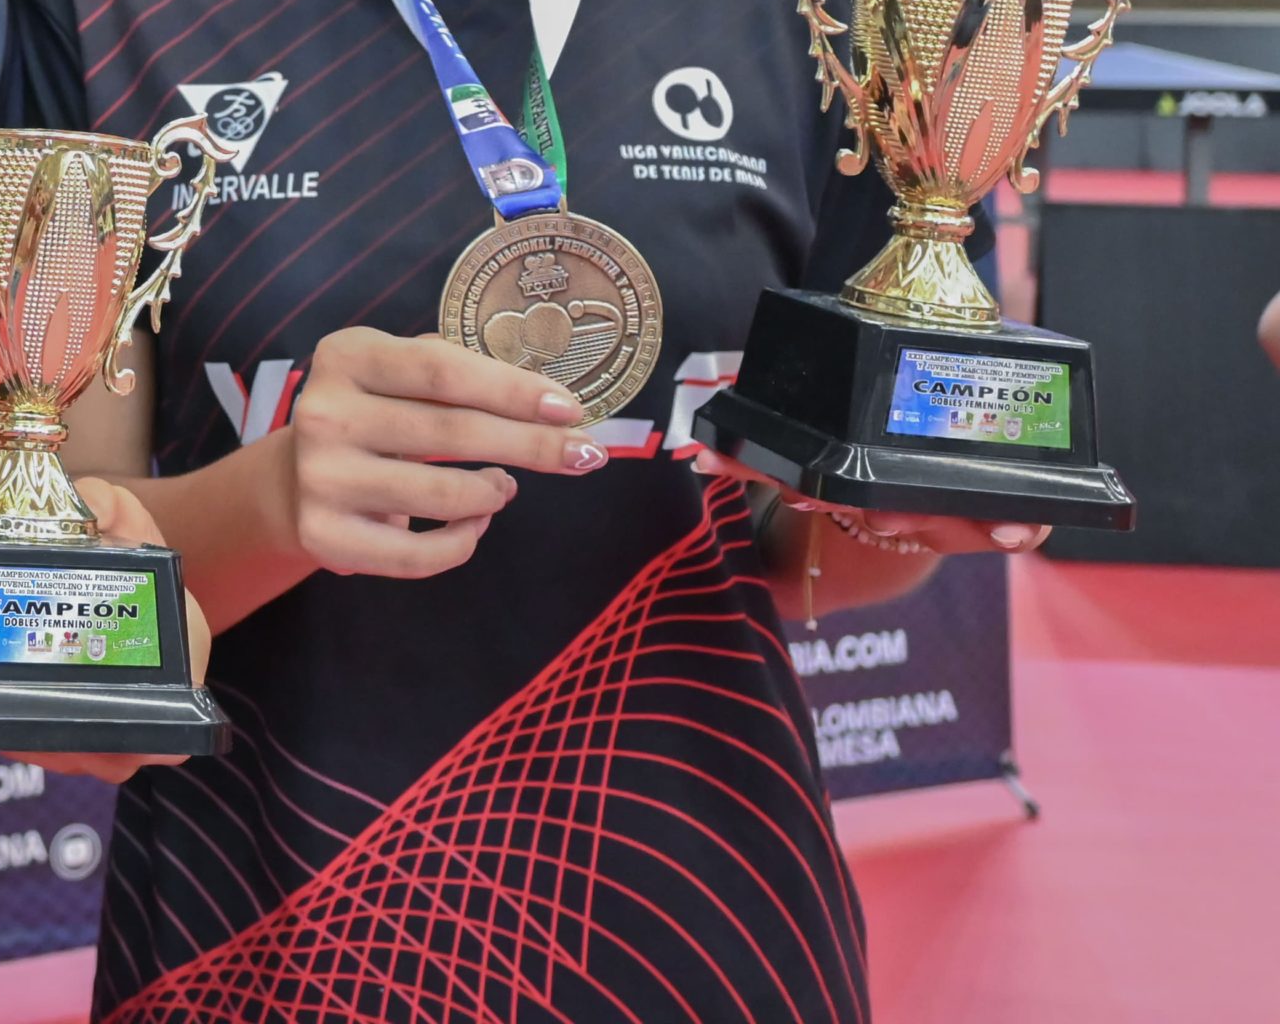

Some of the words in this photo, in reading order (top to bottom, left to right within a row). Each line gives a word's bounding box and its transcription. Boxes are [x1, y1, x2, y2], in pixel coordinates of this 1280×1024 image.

[620, 144, 658, 160] LIGA
[633, 163, 658, 180] DE
[660, 164, 706, 182] TENIS
[708, 166, 733, 183] DE
[171, 171, 320, 211] INERVALLE
[463, 260, 501, 336] CAMPEONATO
[925, 354, 975, 365] CAMPEONATO
[975, 360, 1013, 369] NACIONAL
[913, 379, 1053, 405] CAMPEÓN
[931, 397, 963, 408] DOBLES
[965, 400, 1011, 412] FEMENINO
[52, 573, 93, 582] NACIONAL
[94, 574, 147, 584] PREINFANTIL
[35, 581, 83, 591] MASCULINO
[84, 583, 91, 591] Y
[91, 584, 135, 593] FEMENINO
[4, 617, 39, 628] DOBLES
[43, 619, 93, 629] FEMENINO
[96, 620, 118, 630] U-13
